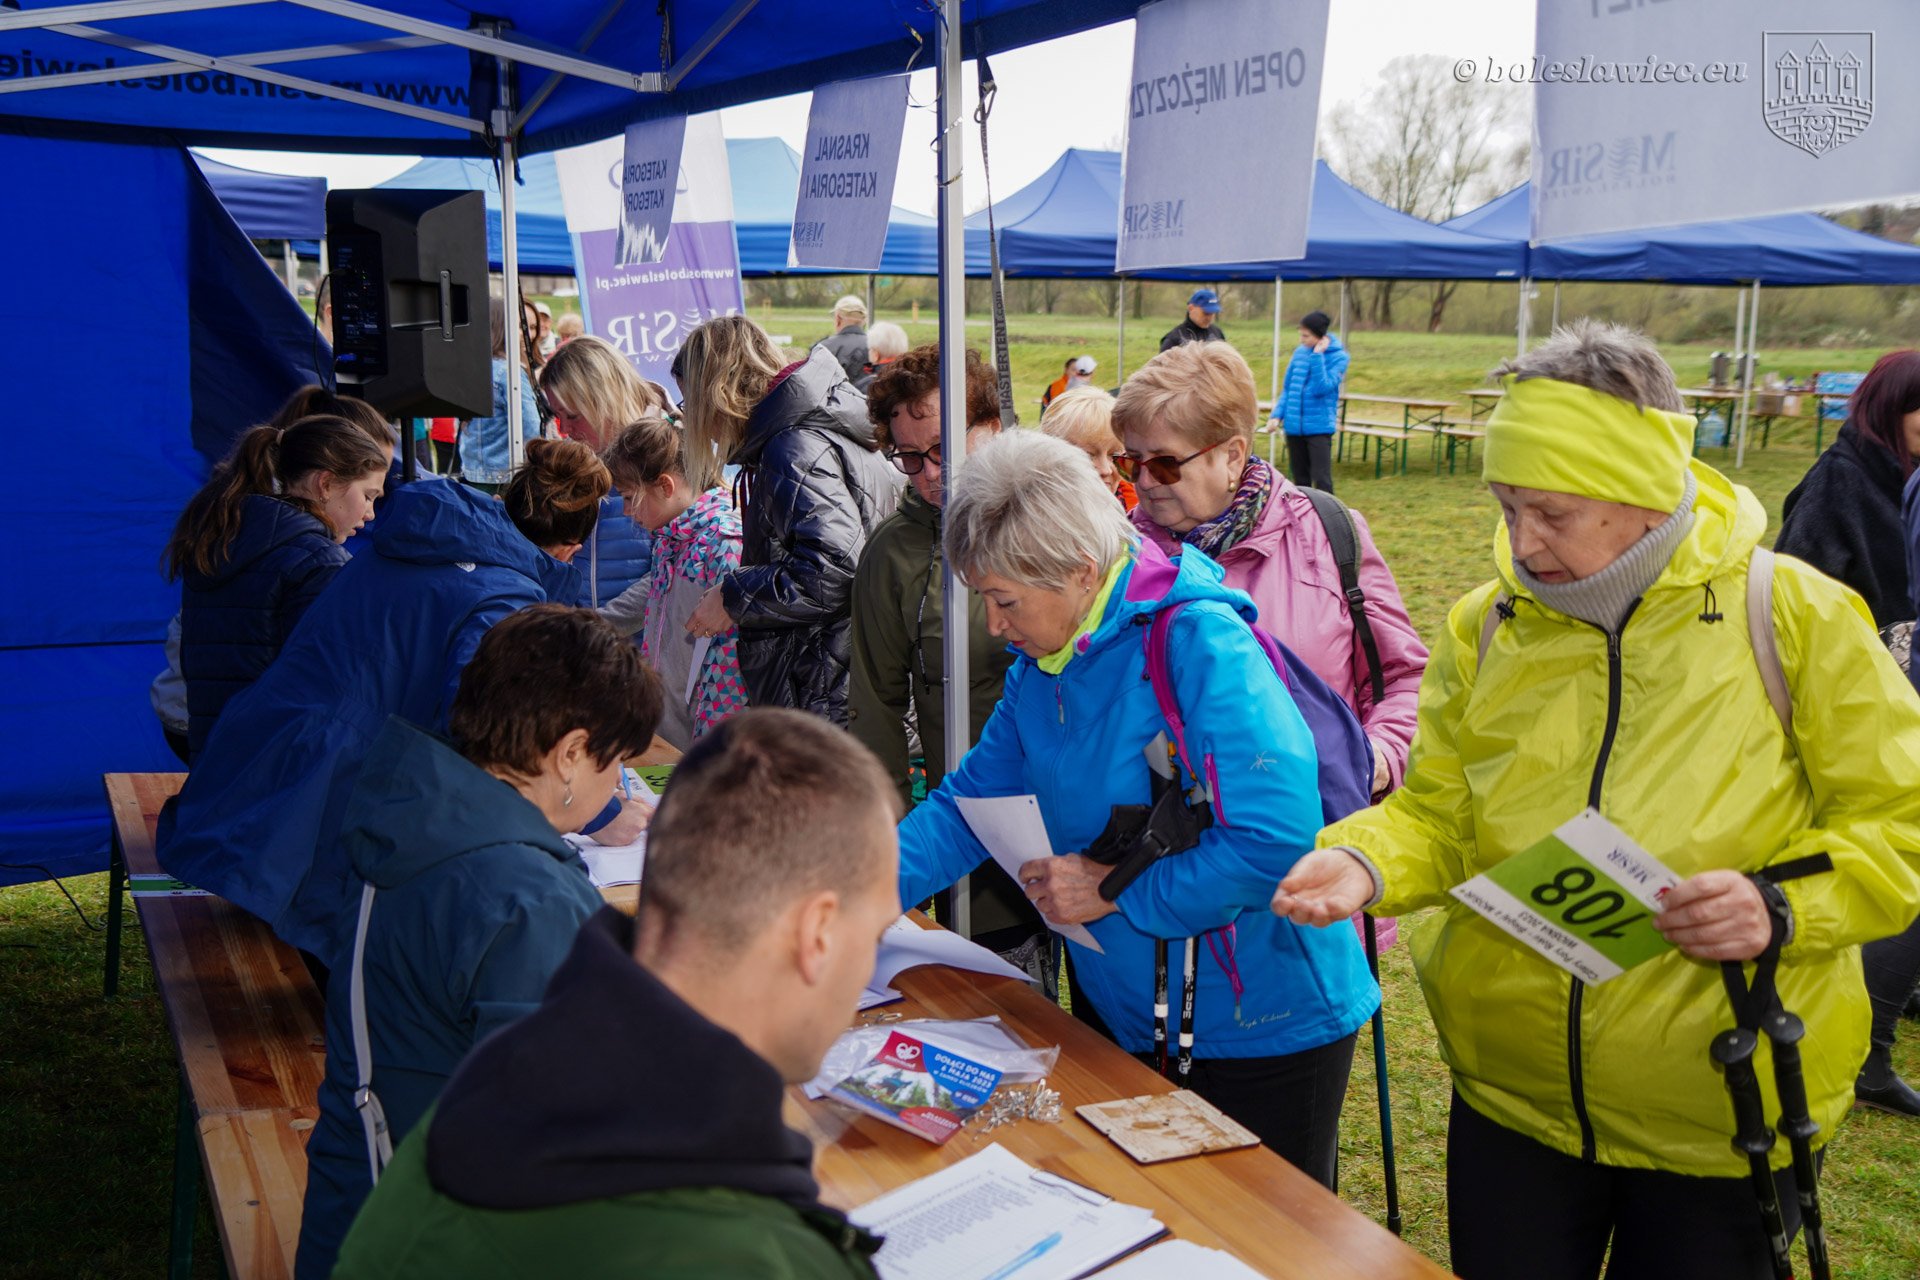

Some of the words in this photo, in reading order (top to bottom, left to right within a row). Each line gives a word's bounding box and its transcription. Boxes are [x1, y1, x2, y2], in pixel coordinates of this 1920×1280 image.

[994, 291, 1012, 410] MASTERTENT.com
[1530, 867, 1649, 939] 108
[965, 1064, 980, 1076] DO
